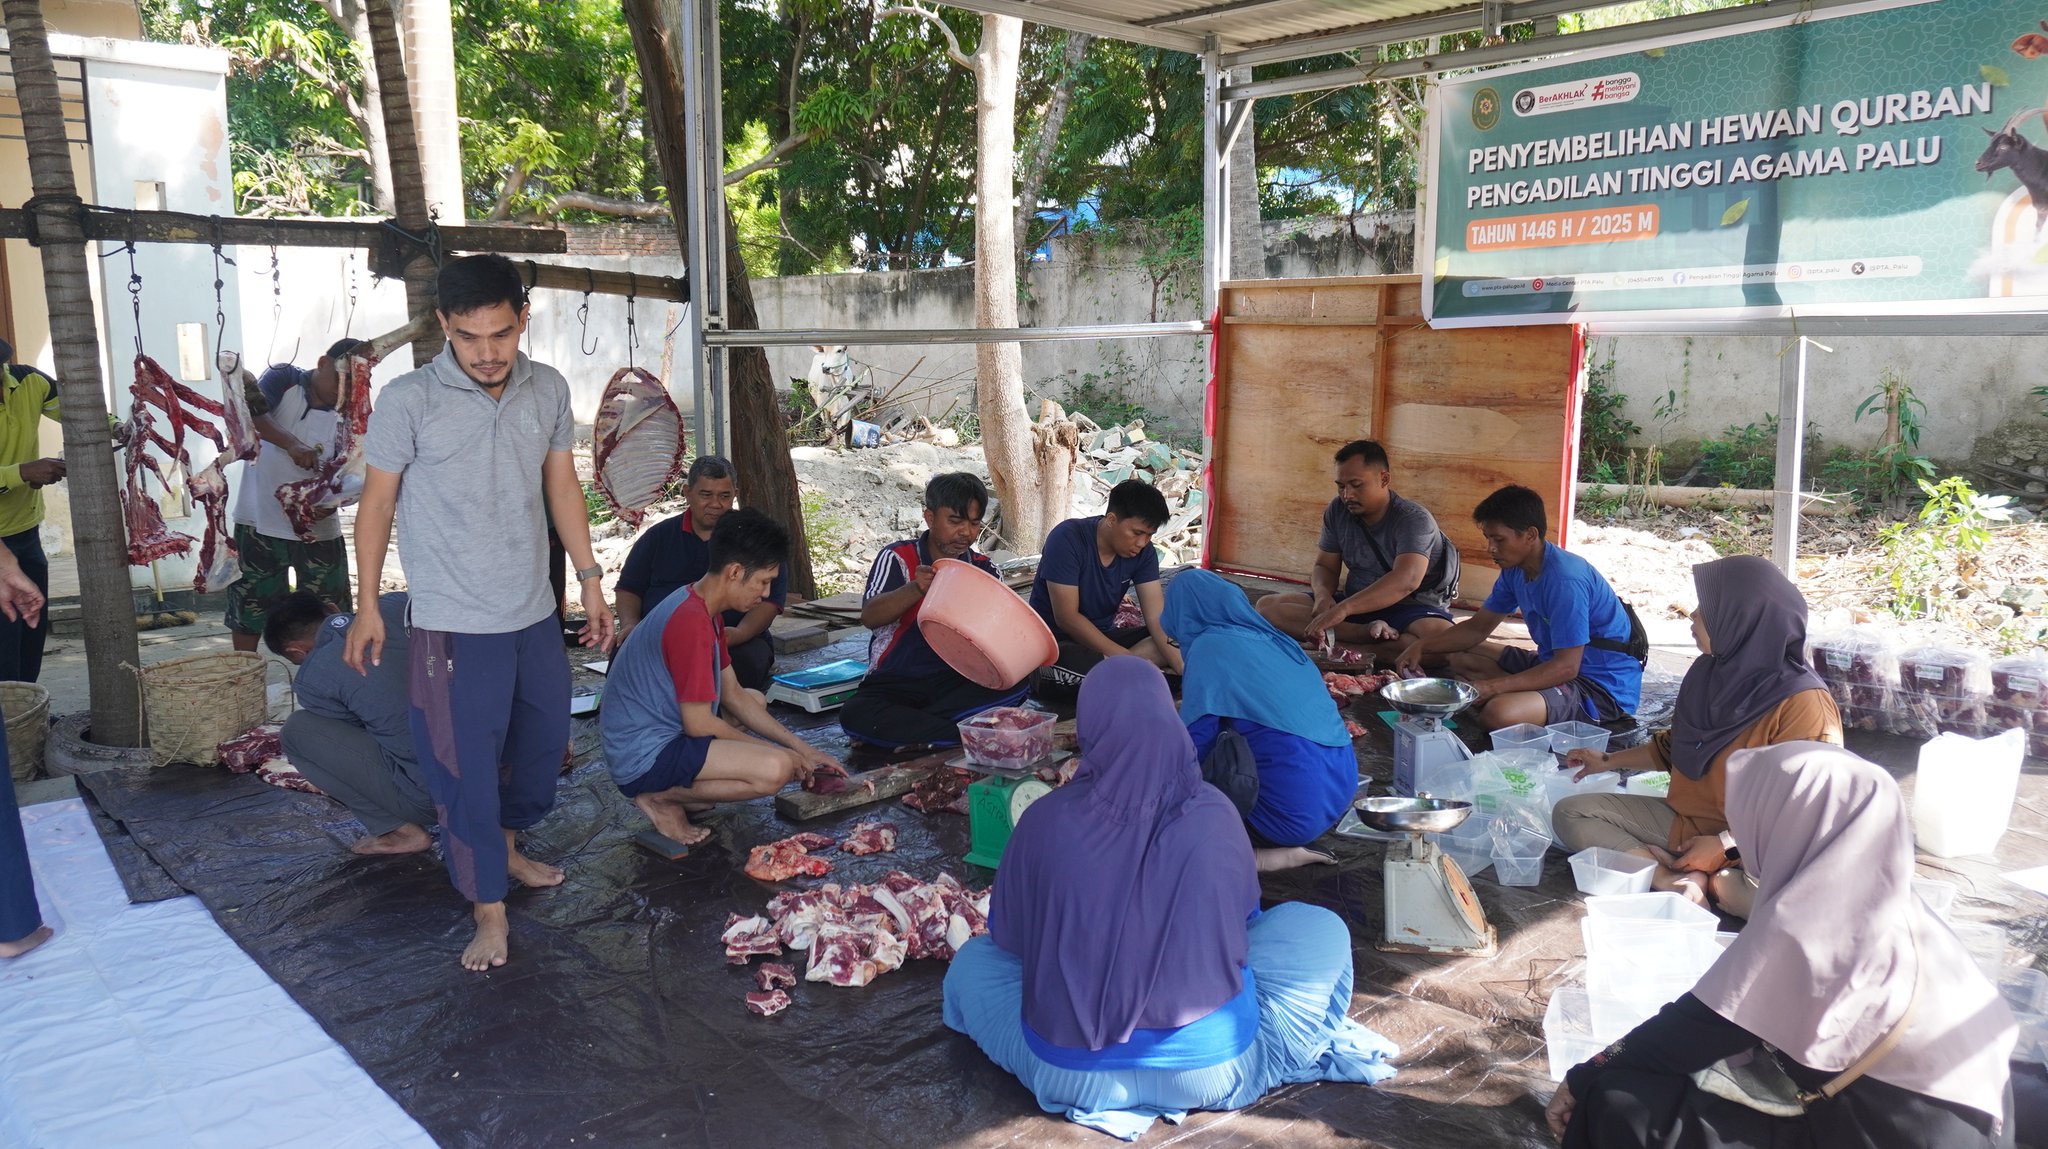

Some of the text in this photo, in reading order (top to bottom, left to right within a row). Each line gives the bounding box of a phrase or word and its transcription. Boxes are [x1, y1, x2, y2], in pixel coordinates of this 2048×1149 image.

[1605, 77, 1632, 87] bangga
[1605, 82, 1637, 93] melayani
[1538, 87, 1586, 104] BerAKHLAK
[1605, 90, 1631, 101] bangsa
[1468, 82, 1991, 173] PENYEMBELIHAN HEWAN QURBAN
[1467, 135, 1941, 208] PENGADILAN TINGGI AGAMA PALU
[1471, 211, 1653, 245] TAHUN 1446 H / 2025 M
[1870, 264, 1908, 272] @PTA_Palu
[1688, 269, 1779, 282] Pengadilan Tinggi Agama Palu
